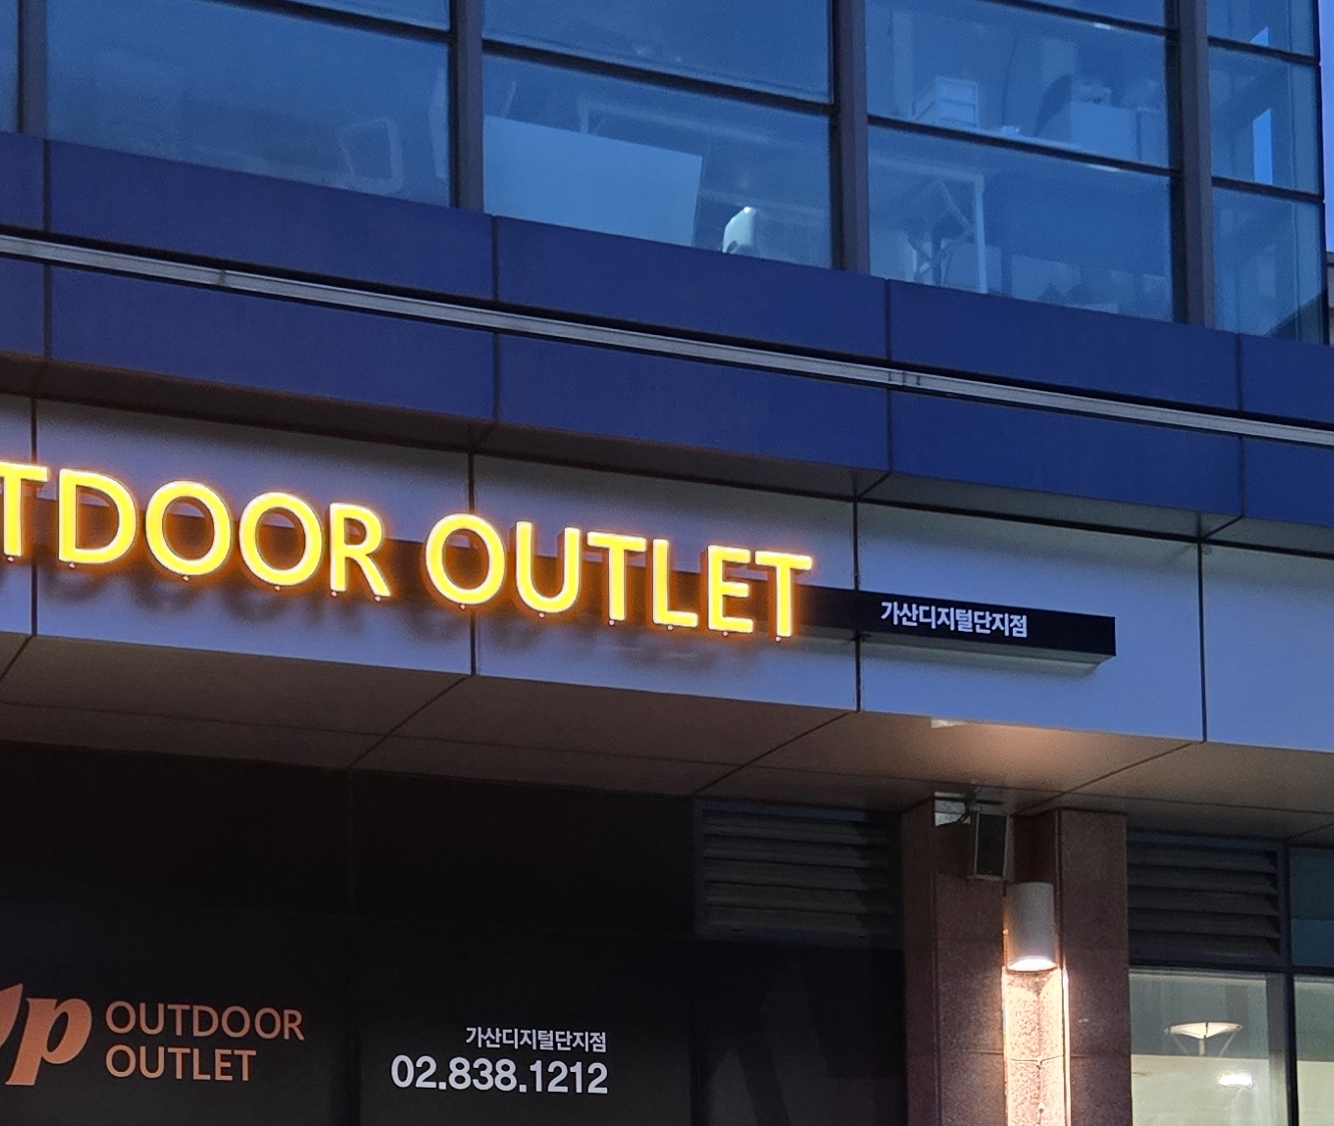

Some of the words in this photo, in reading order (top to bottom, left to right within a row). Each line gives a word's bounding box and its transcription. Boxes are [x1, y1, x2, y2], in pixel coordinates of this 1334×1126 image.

[424, 511, 814, 639] OUTLET
[881, 601, 1028, 638] 가산디지털단지점
[105, 1000, 305, 1041] OUTDOOR
[466, 1027, 606, 1052] 가산디지털단지점
[105, 1044, 257, 1082] OUTLET
[391, 1054, 608, 1094] 02.838.1212
